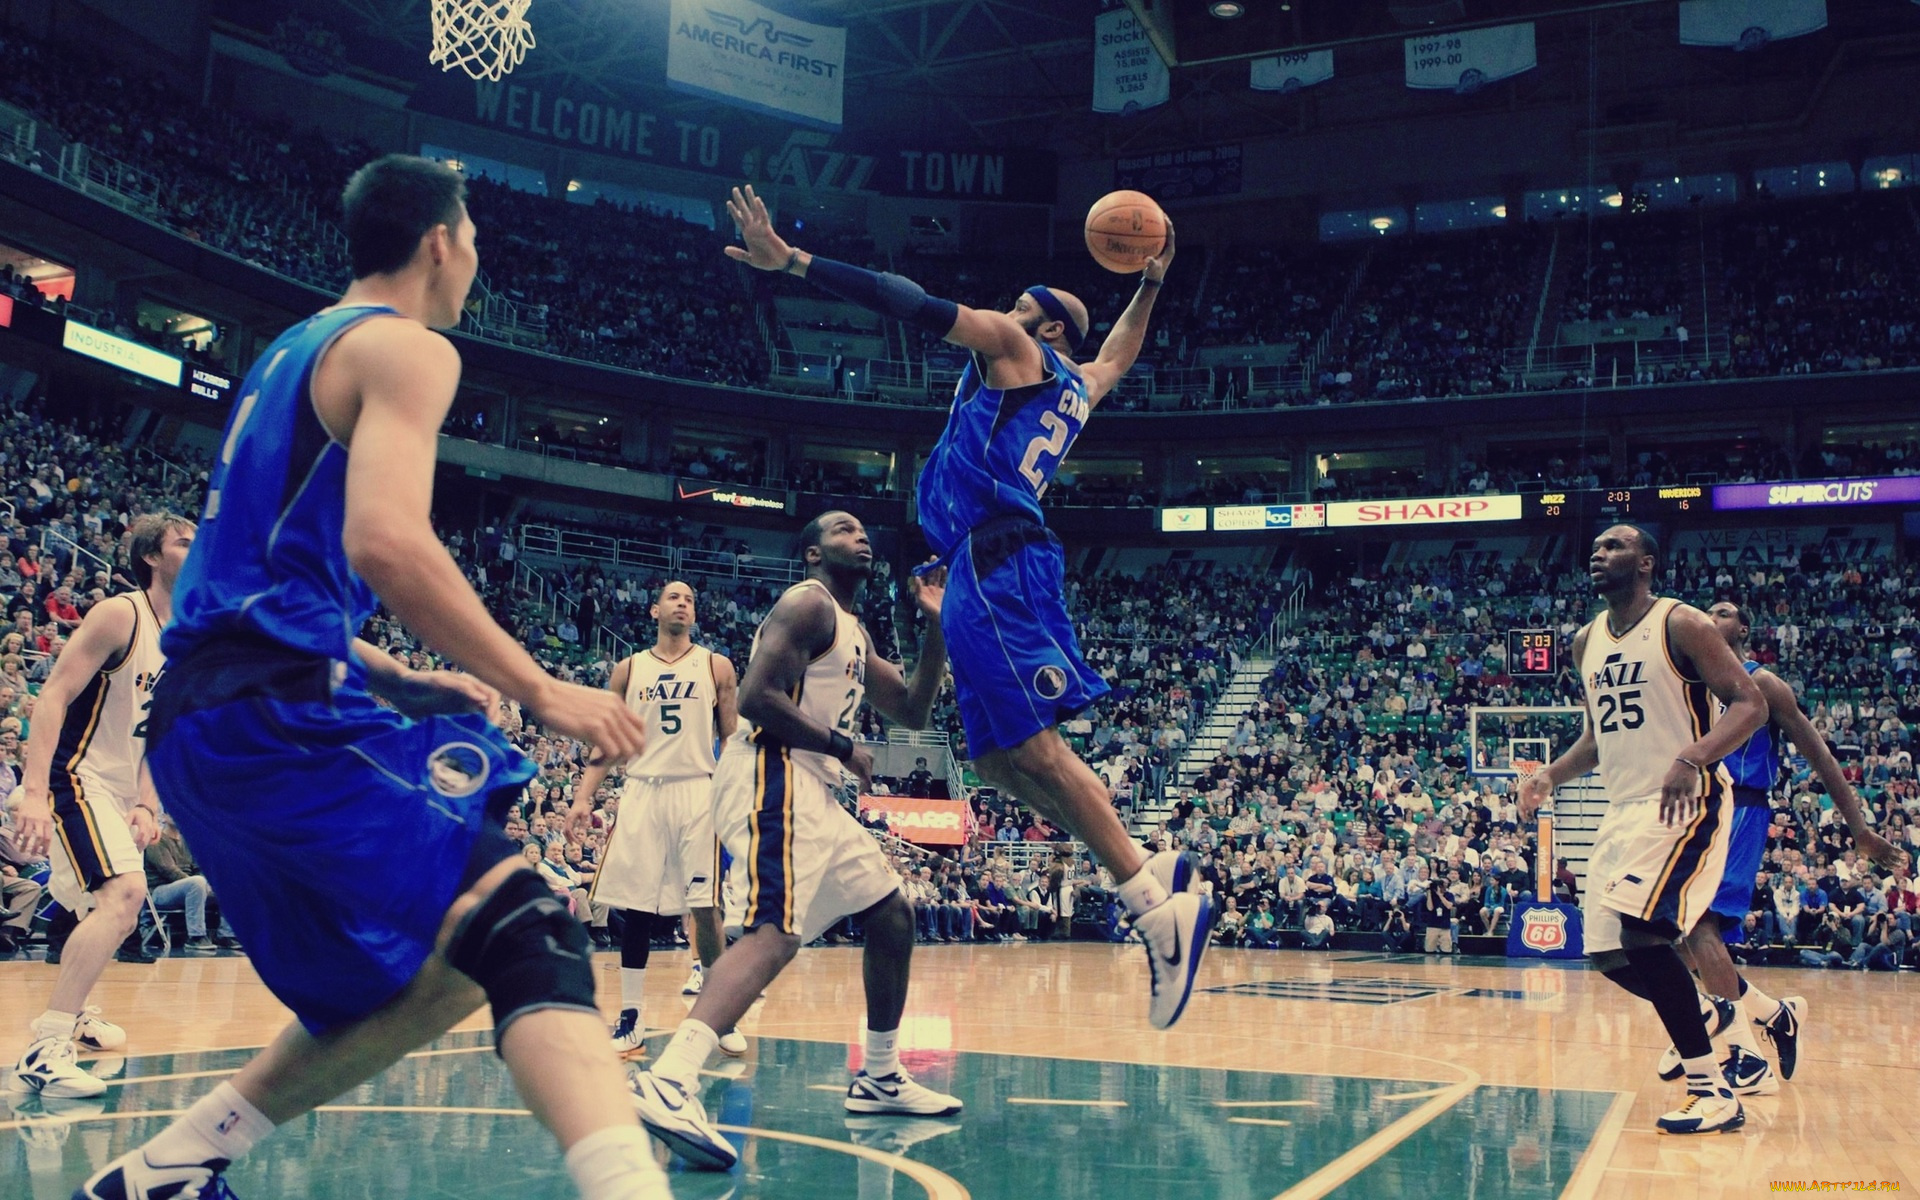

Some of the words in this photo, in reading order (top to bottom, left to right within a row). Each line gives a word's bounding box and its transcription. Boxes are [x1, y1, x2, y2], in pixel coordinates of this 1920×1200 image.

[1101, 31, 1145, 46] Stockt
[1412, 38, 1462, 56] 1997-98
[676, 22, 773, 62] AMERICA
[778, 51, 838, 78] FIRST
[1114, 47, 1150, 60] ASSISTS
[1275, 53, 1310, 67] 1999
[1413, 53, 1462, 70] 1999-00
[1115, 72, 1149, 85] STEALS
[475, 79, 658, 157] WELCOME
[674, 119, 721, 168] TO
[901, 150, 1004, 195] TOWN
[190, 382, 219, 400] BULLS
[1540, 494, 1565, 504] JAZZ
[1607, 491, 1631, 502] 2:03
[1768, 482, 1877, 505] SUPERCUTS
[1358, 500, 1489, 522] SHARP
[1546, 505, 1560, 516] 20
[1679, 500, 1690, 510] 16
[1700, 531, 1738, 545] WE
[1526, 648, 1549, 670] 13
[1590, 652, 1649, 691] JAZZ
[639, 674, 700, 702] JAZZ
[660, 704, 683, 735] 5
[1598, 690, 1645, 734] 25
[1528, 914, 1560, 923] PHILLIPS
[1530, 925, 1557, 943] 66
